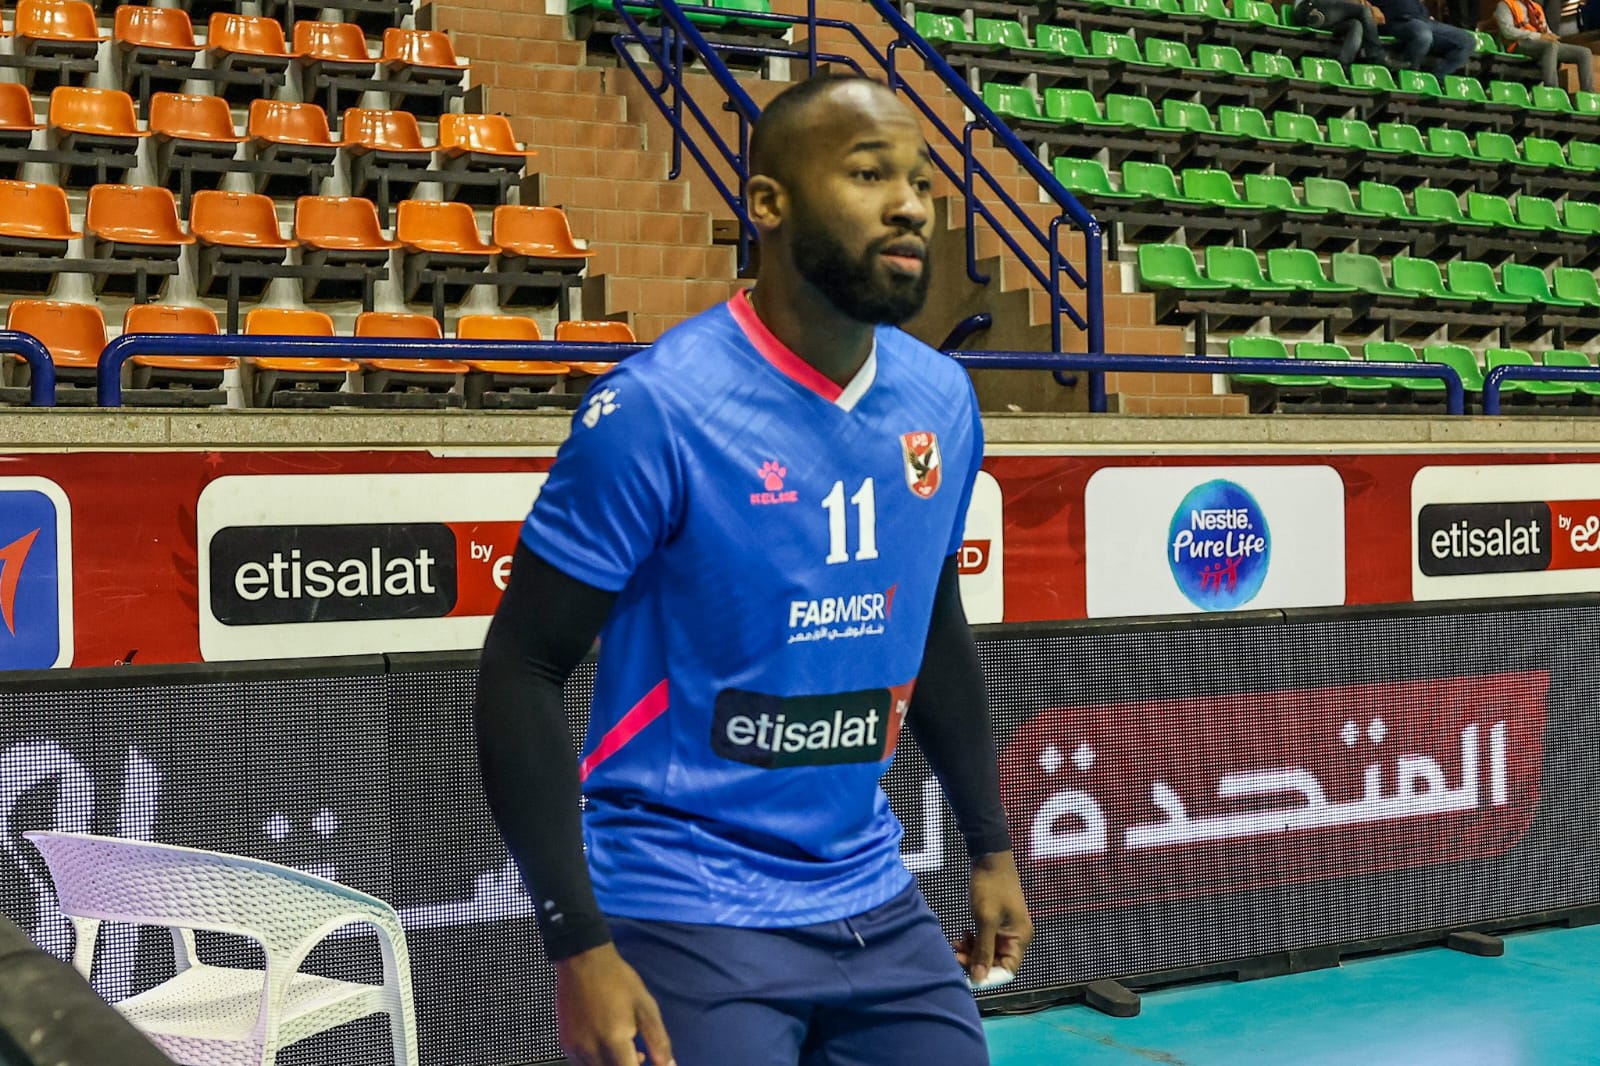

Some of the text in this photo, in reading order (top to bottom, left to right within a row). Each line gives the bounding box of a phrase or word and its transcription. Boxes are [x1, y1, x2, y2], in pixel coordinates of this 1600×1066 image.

[821, 477, 880, 565] 11
[1431, 519, 1541, 559] etisalat
[1558, 514, 1572, 531] by
[234, 547, 435, 601] etisalat
[470, 541, 493, 563] by
[788, 592, 885, 628] FABMISR
[726, 708, 880, 753] etisalat
[1029, 717, 1508, 860] المتحدة
